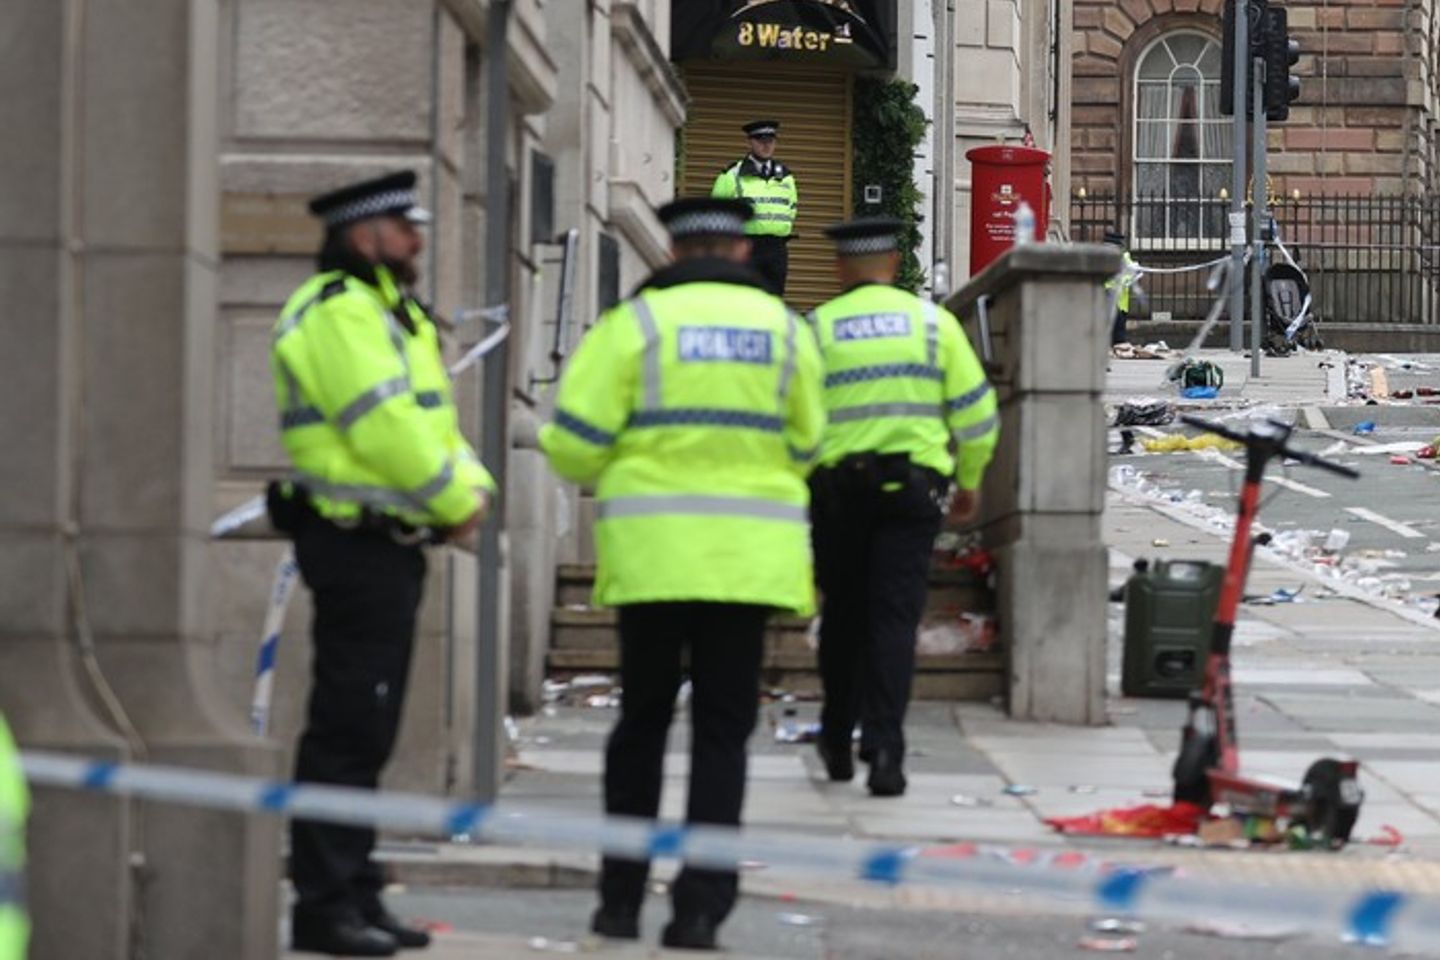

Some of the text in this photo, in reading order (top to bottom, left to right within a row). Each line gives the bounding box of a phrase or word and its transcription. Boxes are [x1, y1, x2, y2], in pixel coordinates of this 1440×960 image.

[738, 21, 754, 46] 8
[757, 23, 830, 52] Water
[834, 313, 909, 340] POLICE
[680, 328, 768, 362] POLICE
